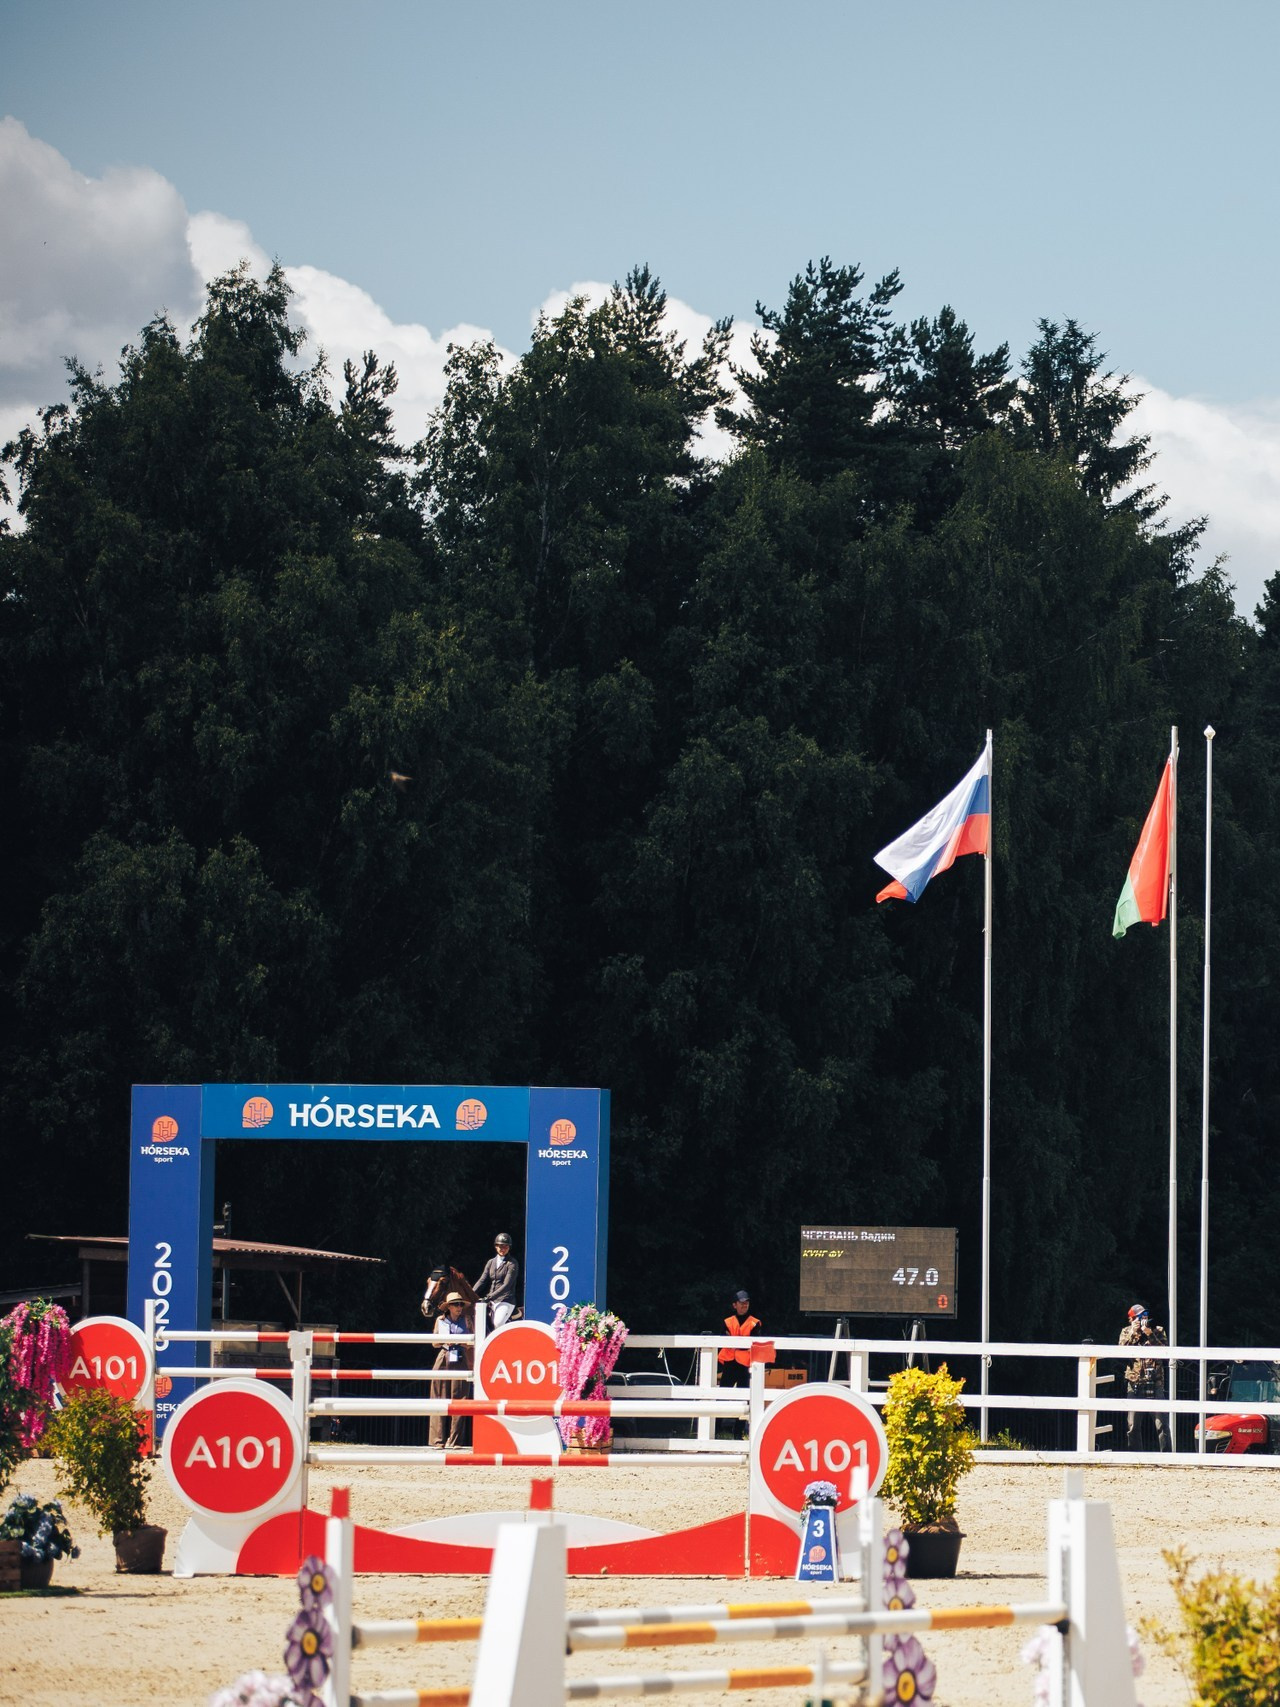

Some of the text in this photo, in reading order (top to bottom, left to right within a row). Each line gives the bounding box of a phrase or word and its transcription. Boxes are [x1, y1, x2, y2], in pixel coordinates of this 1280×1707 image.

[288, 1095, 441, 1129] HÓRSEKA
[140, 1144, 190, 1156] HÓRSEKA
[538, 1147, 588, 1159] HÓRSEKA
[154, 1156, 174, 1164] sport
[802, 1230, 896, 1243] ЧЕРЕВАНЬ Вадим
[802, 1249, 828, 1257] КУНГ
[892, 1267, 939, 1286] 47.0
[937, 1294, 948, 1309] 0
[69, 1355, 137, 1380] A101
[489, 1359, 558, 1385] A101
[184, 1435, 282, 1470] A101
[772, 1439, 868, 1473] A101
[813, 1519, 825, 1537] 3
[802, 1563, 833, 1571] HÓRSEKA
